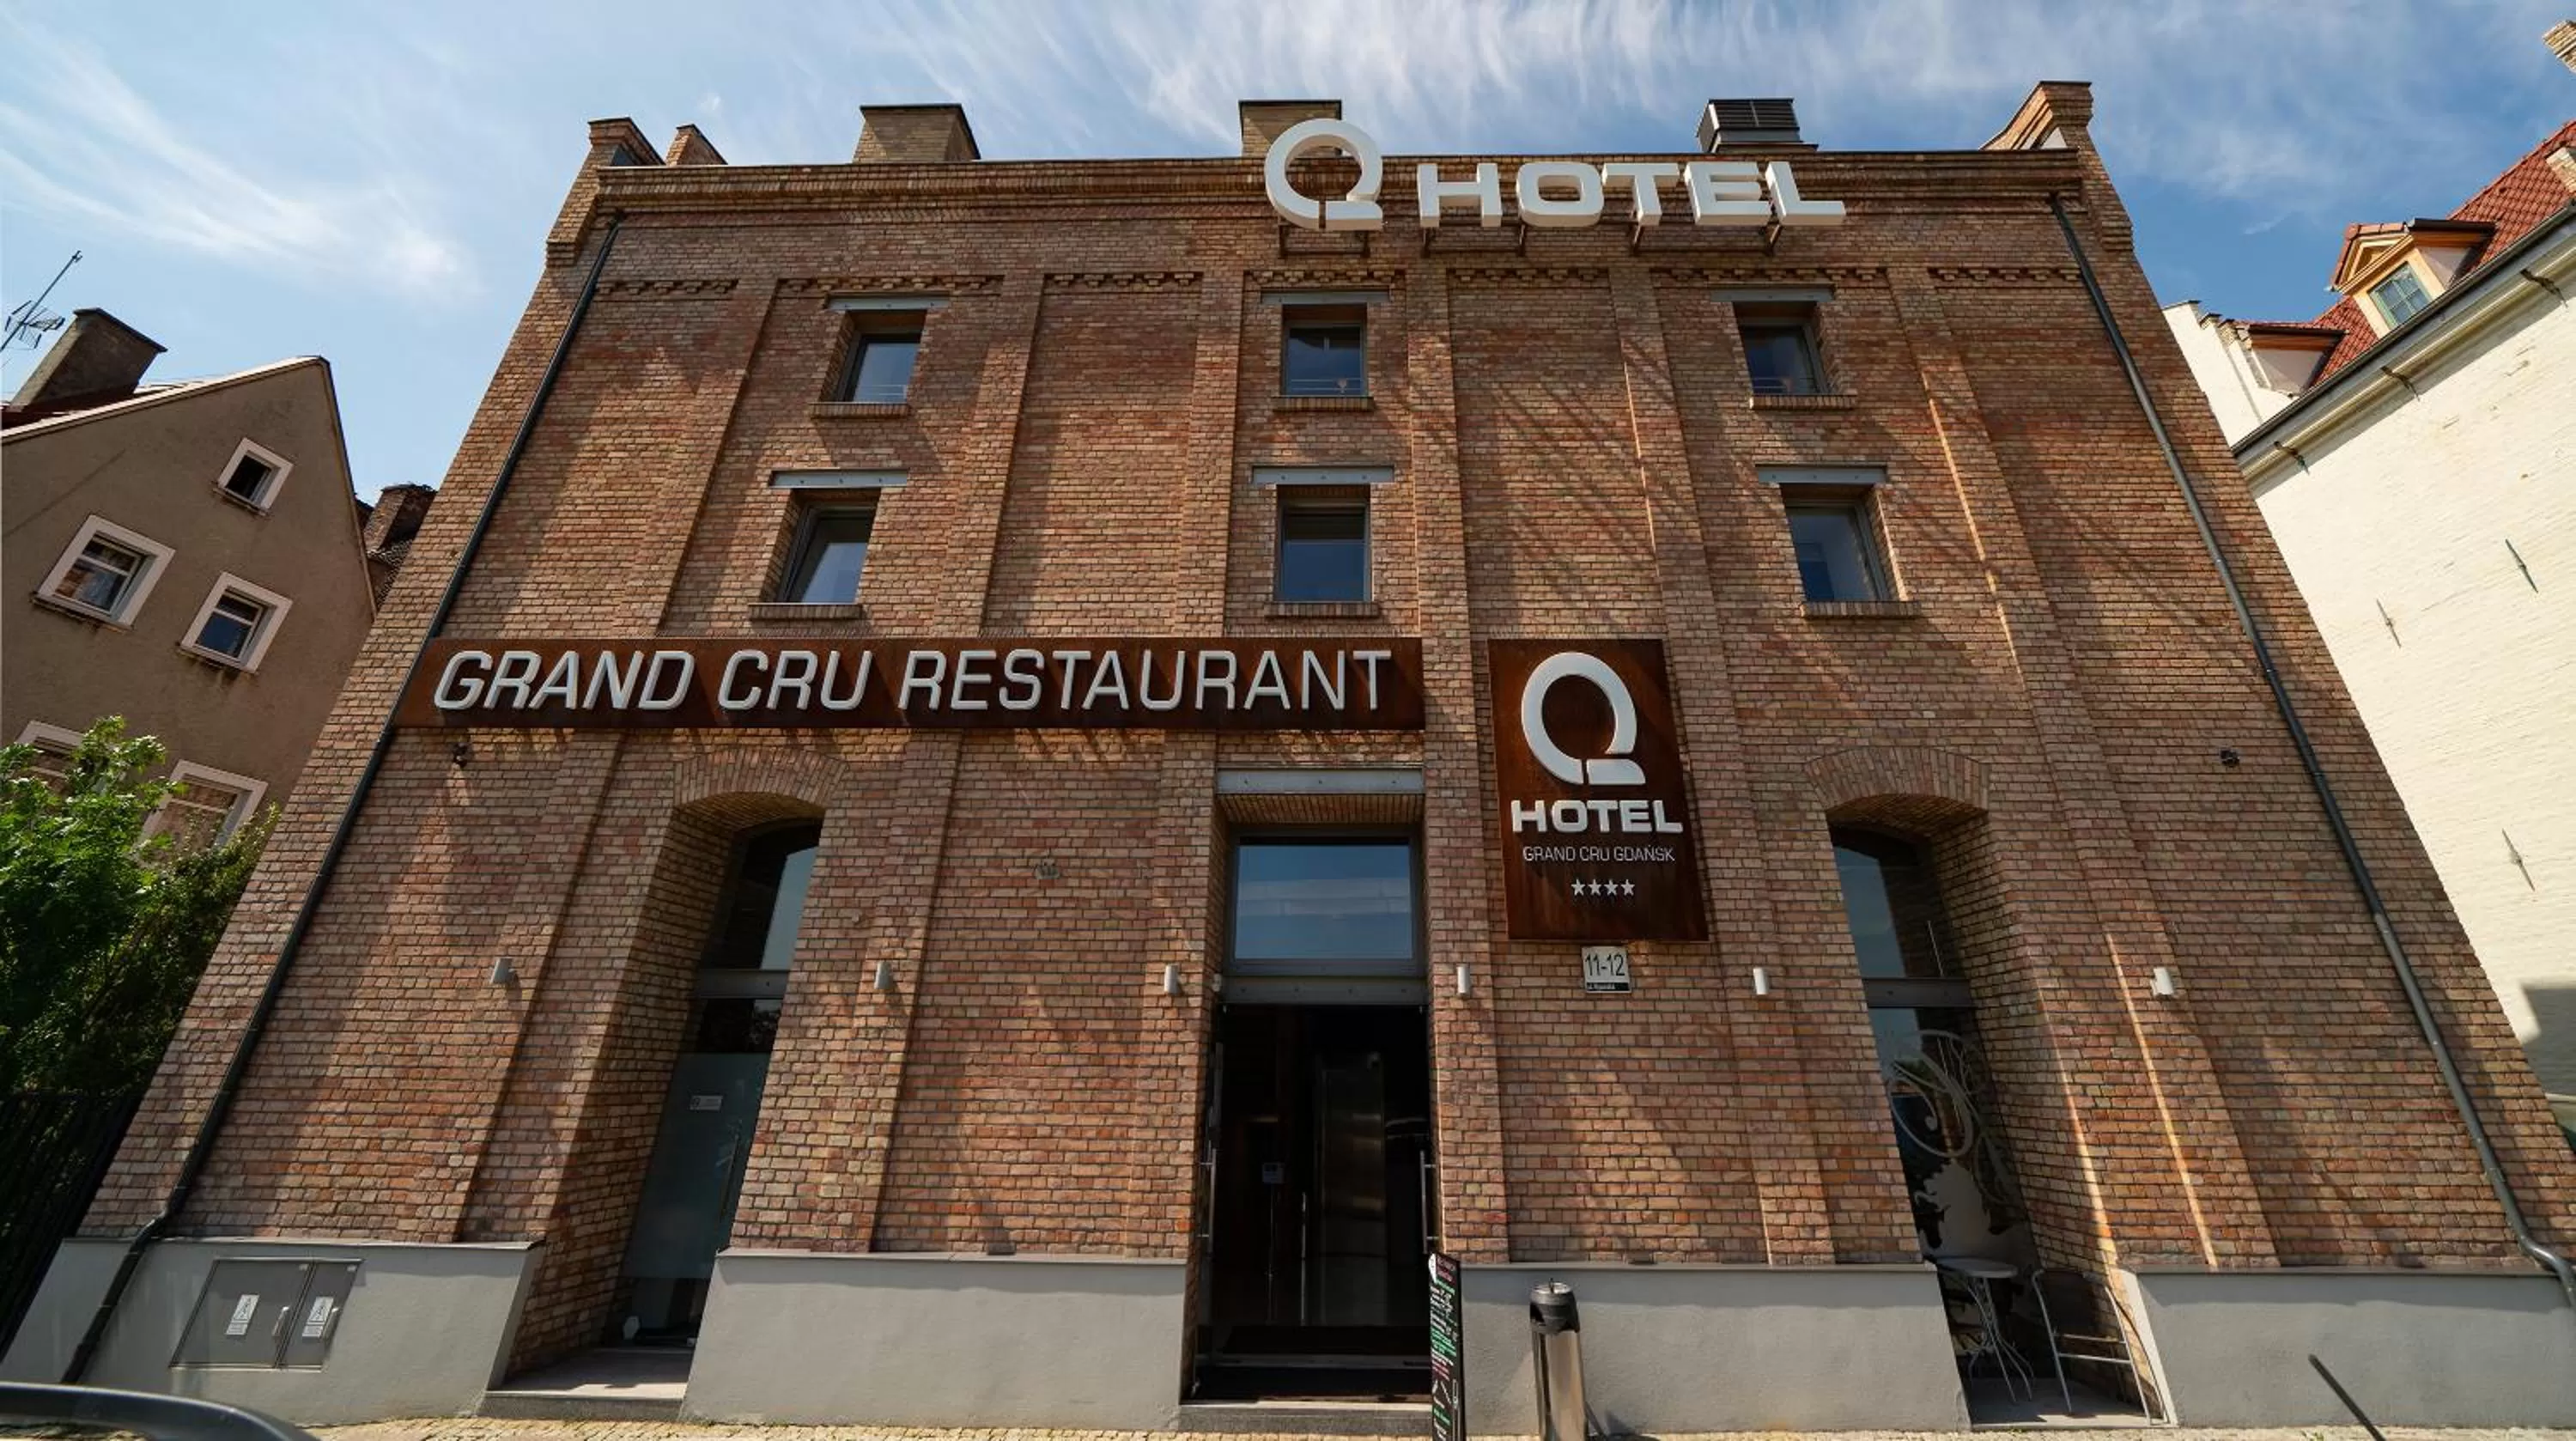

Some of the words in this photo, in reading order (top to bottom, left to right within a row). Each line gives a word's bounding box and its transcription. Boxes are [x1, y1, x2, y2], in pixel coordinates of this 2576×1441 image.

[1264, 119, 1384, 232] Q
[1416, 161, 1847, 228] HOTEL
[433, 649, 696, 711] GRAND
[716, 648, 873, 711] CRU
[896, 648, 1392, 711] RESTAURANT
[1521, 651, 1646, 786] Q
[1510, 800, 1684, 833] HOTEL
[1522, 846, 1577, 861] GRAND
[1579, 846, 1610, 861] CRU
[1613, 844, 1675, 862] GDAŃSK
[1584, 953, 1625, 976] 11-12
